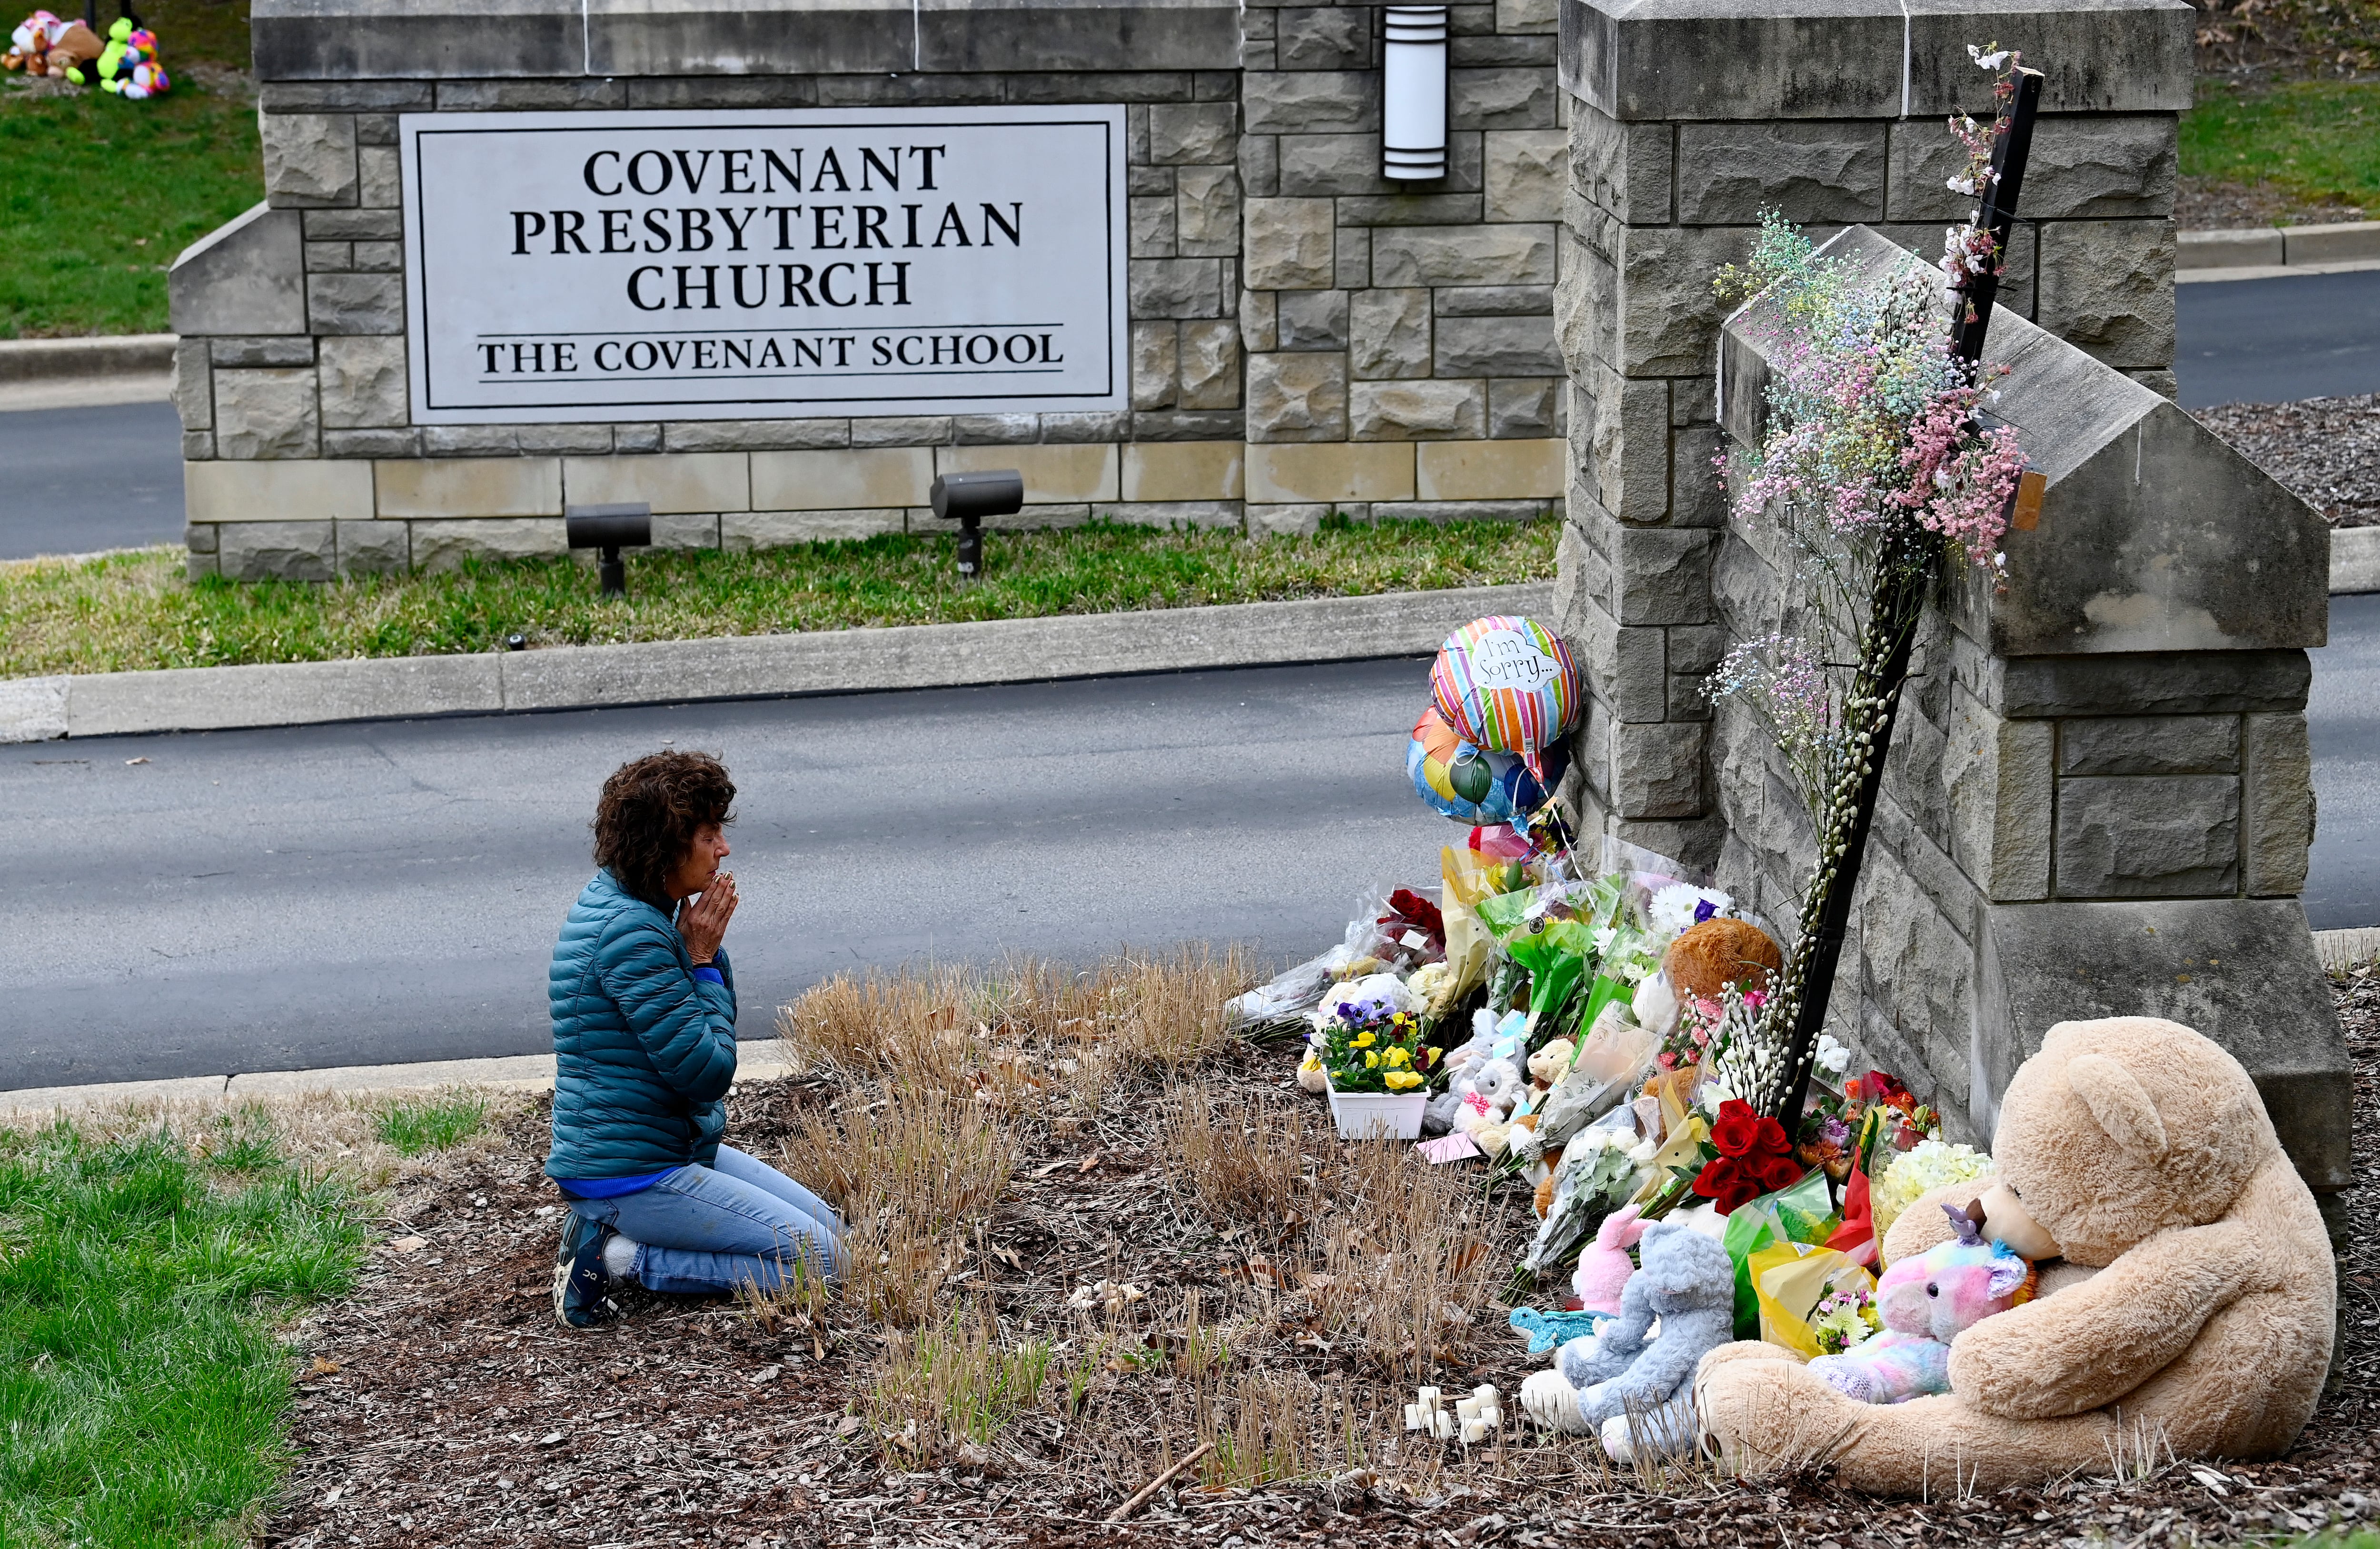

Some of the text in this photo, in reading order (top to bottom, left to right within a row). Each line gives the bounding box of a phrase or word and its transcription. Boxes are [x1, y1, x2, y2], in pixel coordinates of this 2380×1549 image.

[584, 144, 945, 196] COVENANT
[510, 202, 1023, 255] PRESBYTERIAN
[627, 262, 912, 311] CHURCH
[477, 334, 1063, 373] THE COVENANT SCHOOL
[1484, 638, 1521, 657] I'm
